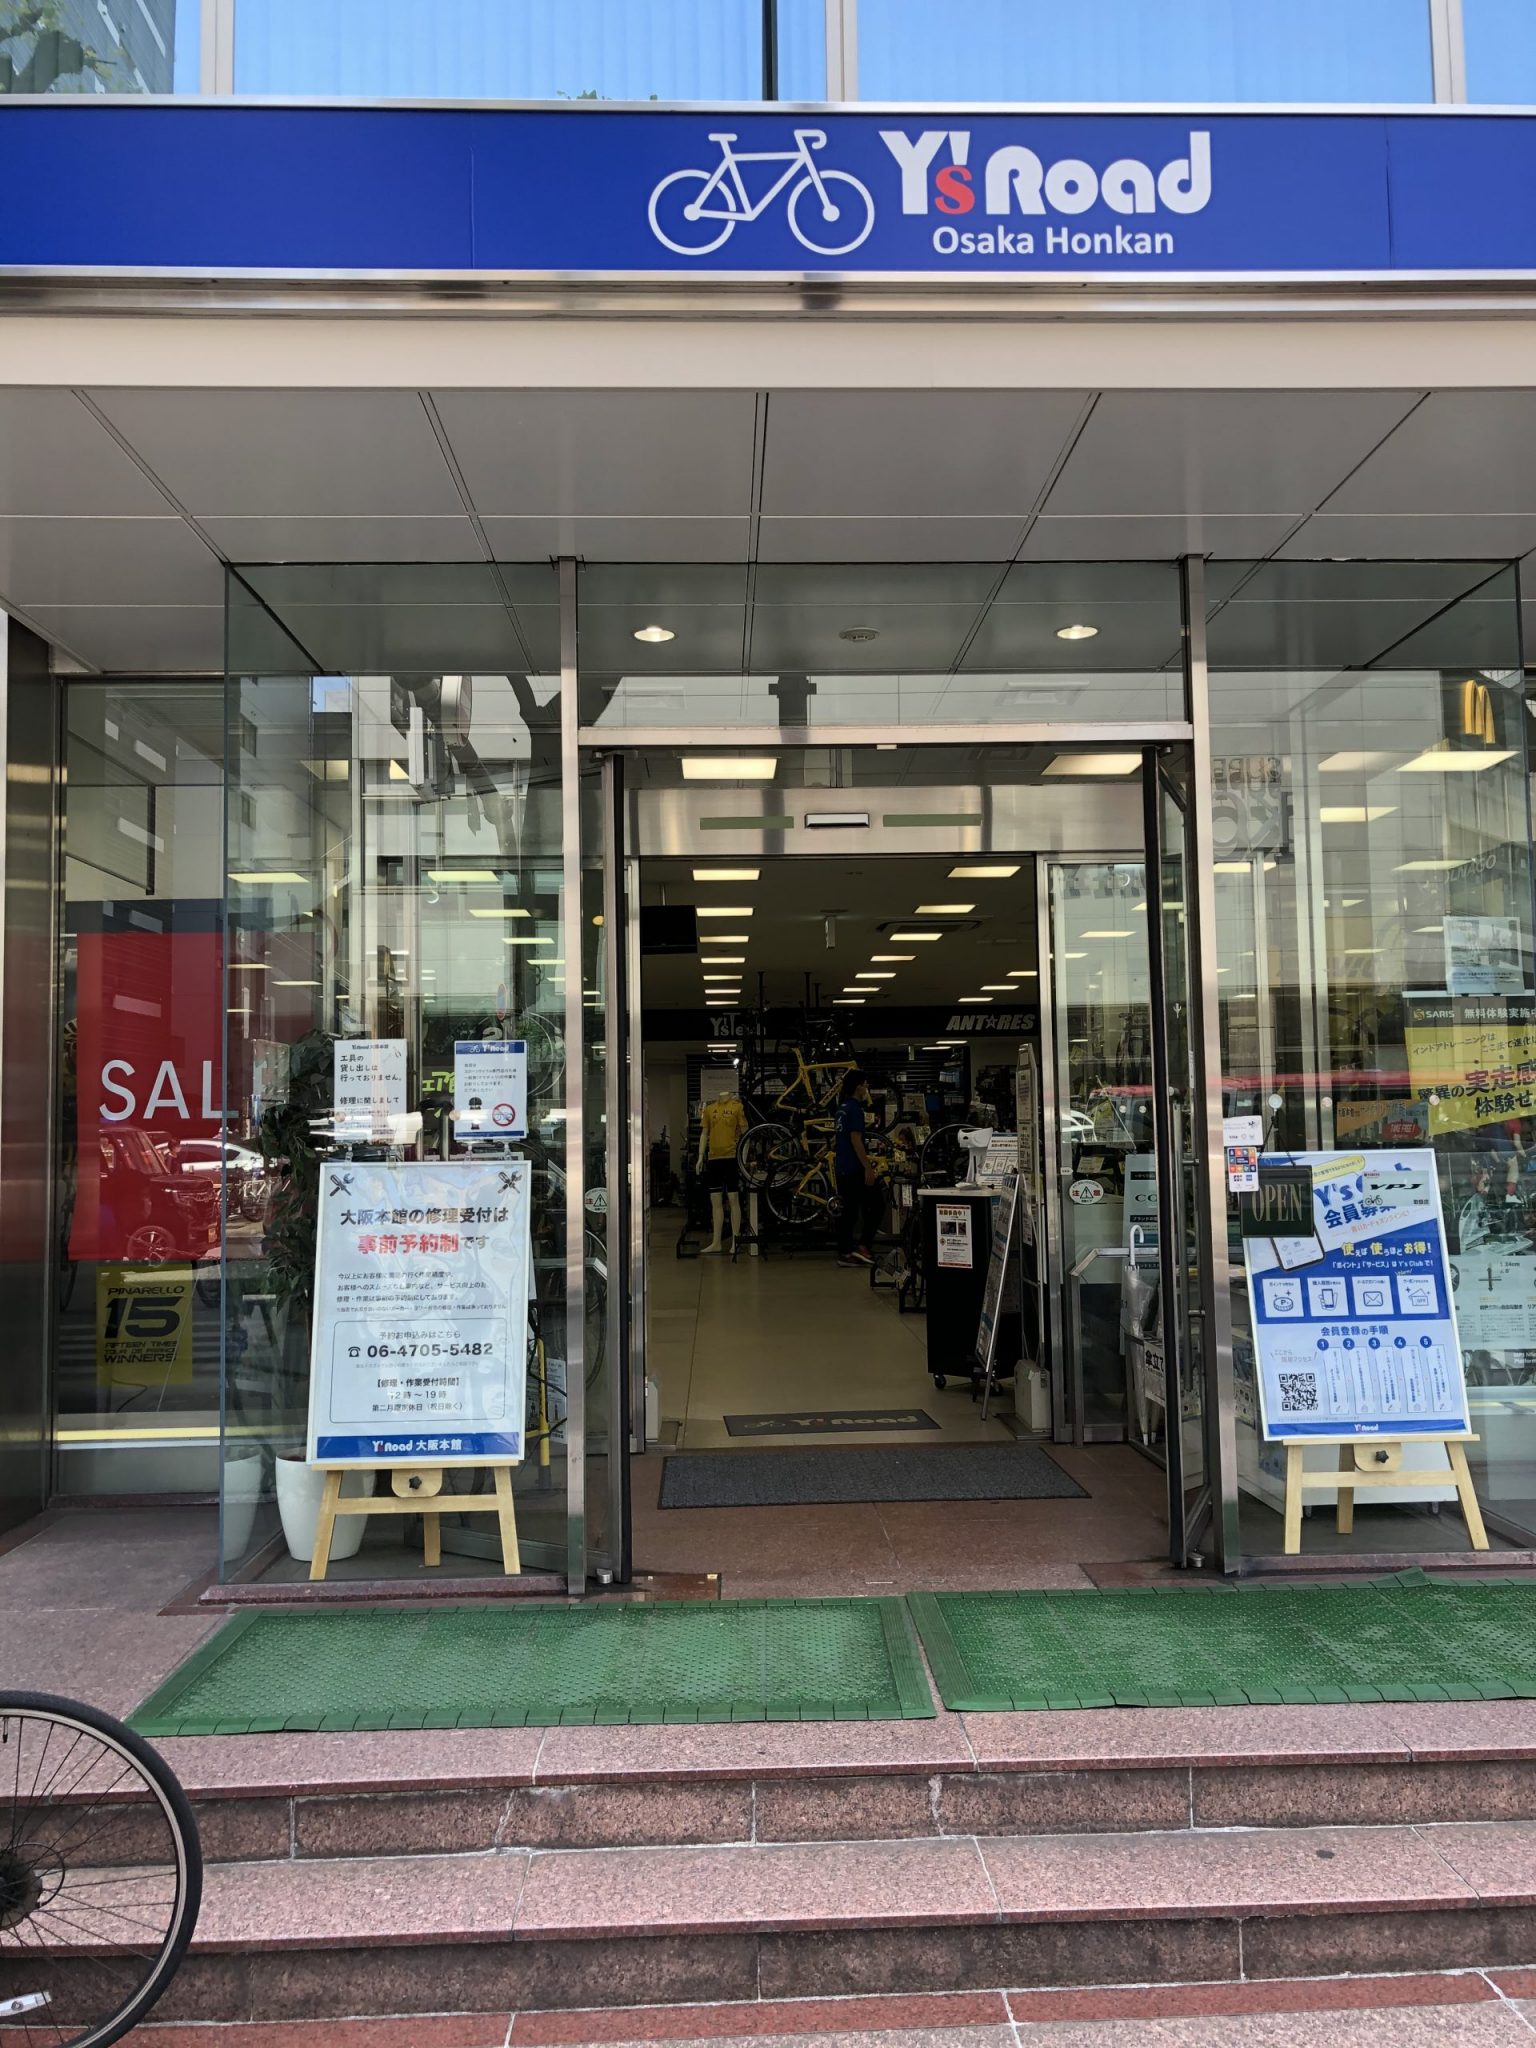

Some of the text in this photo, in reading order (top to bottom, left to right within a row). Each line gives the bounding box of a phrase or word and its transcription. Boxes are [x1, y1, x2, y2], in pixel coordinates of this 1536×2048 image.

[985, 131, 1211, 215] Road
[932, 225, 1174, 255] Osaka Honkan
[1425, 1010, 1455, 1018] SARIS
[340, 1054, 364, 1062] 工具の
[340, 1064, 379, 1072] 貸し出しは
[340, 1074, 402, 1082] 行っておりません。
[340, 1096, 400, 1105] 修理に関しまして
[1475, 1090, 1536, 1118] 体験せ
[1251, 1183, 1305, 1222] OPEN
[1314, 1183, 1354, 1207] Y's
[340, 1207, 509, 1226] 大阪本館の修理受付は
[357, 1234, 490, 1255] 事前予約制です
[108, 1286, 185, 1295] PINARELLO
[104, 1296, 184, 1339] 15
[1321, 1325, 1389, 1336] 会員登録の手順
[367, 1342, 494, 1358] 06-4705-5482
[104, 1353, 177, 1363] WINNERS
[384, 1439, 413, 1452] Road
[415, 1438, 463, 1451] 大阪本館
